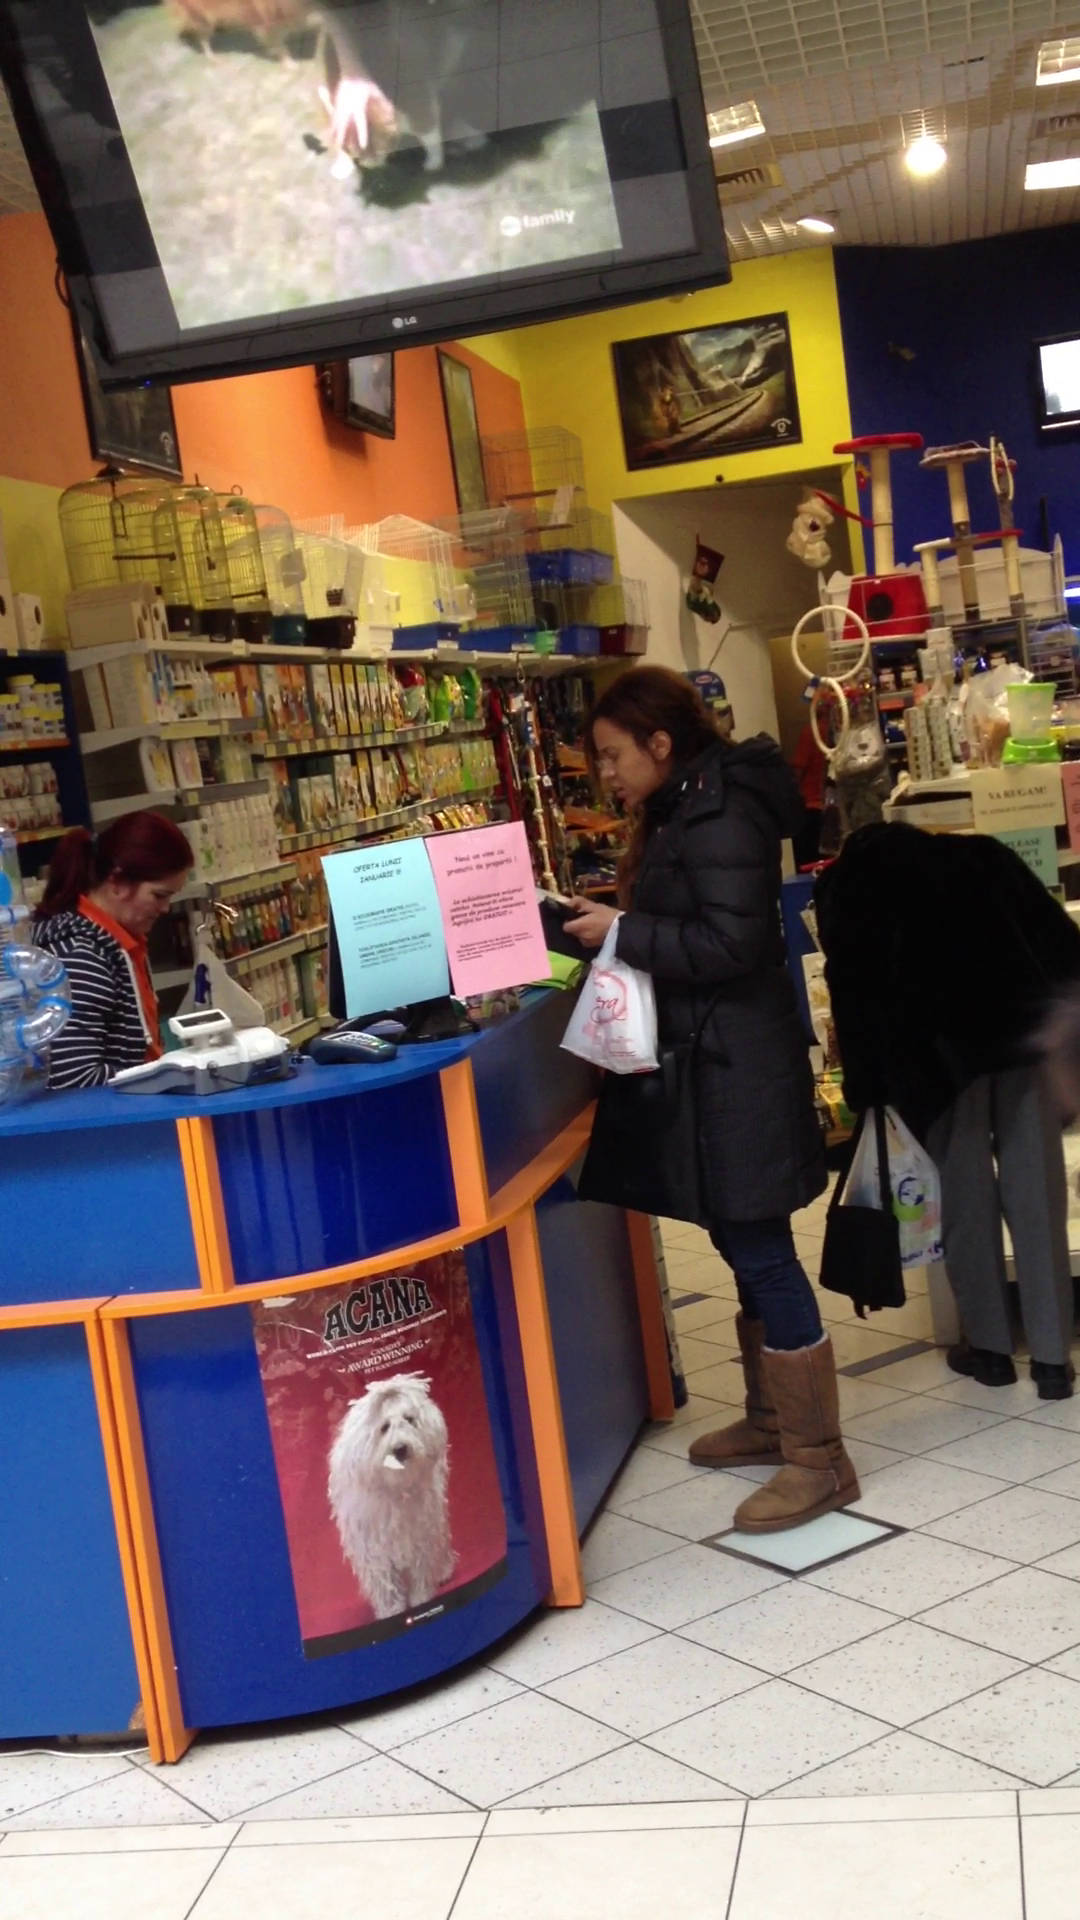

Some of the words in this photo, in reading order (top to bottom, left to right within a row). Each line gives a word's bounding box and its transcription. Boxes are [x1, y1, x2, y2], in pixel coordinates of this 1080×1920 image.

[523, 209, 575, 228] family
[404, 316, 417, 325] LG
[353, 863, 380, 873] OFERTA
[381, 857, 402, 867] LUNII
[360, 870, 394, 883] IANUARIE
[323, 1277, 433, 1341] ACANA
[358, 1338, 373, 1346] FOOD
[347, 1355, 382, 1373] AWARD
[382, 1340, 424, 1361] WINNING
